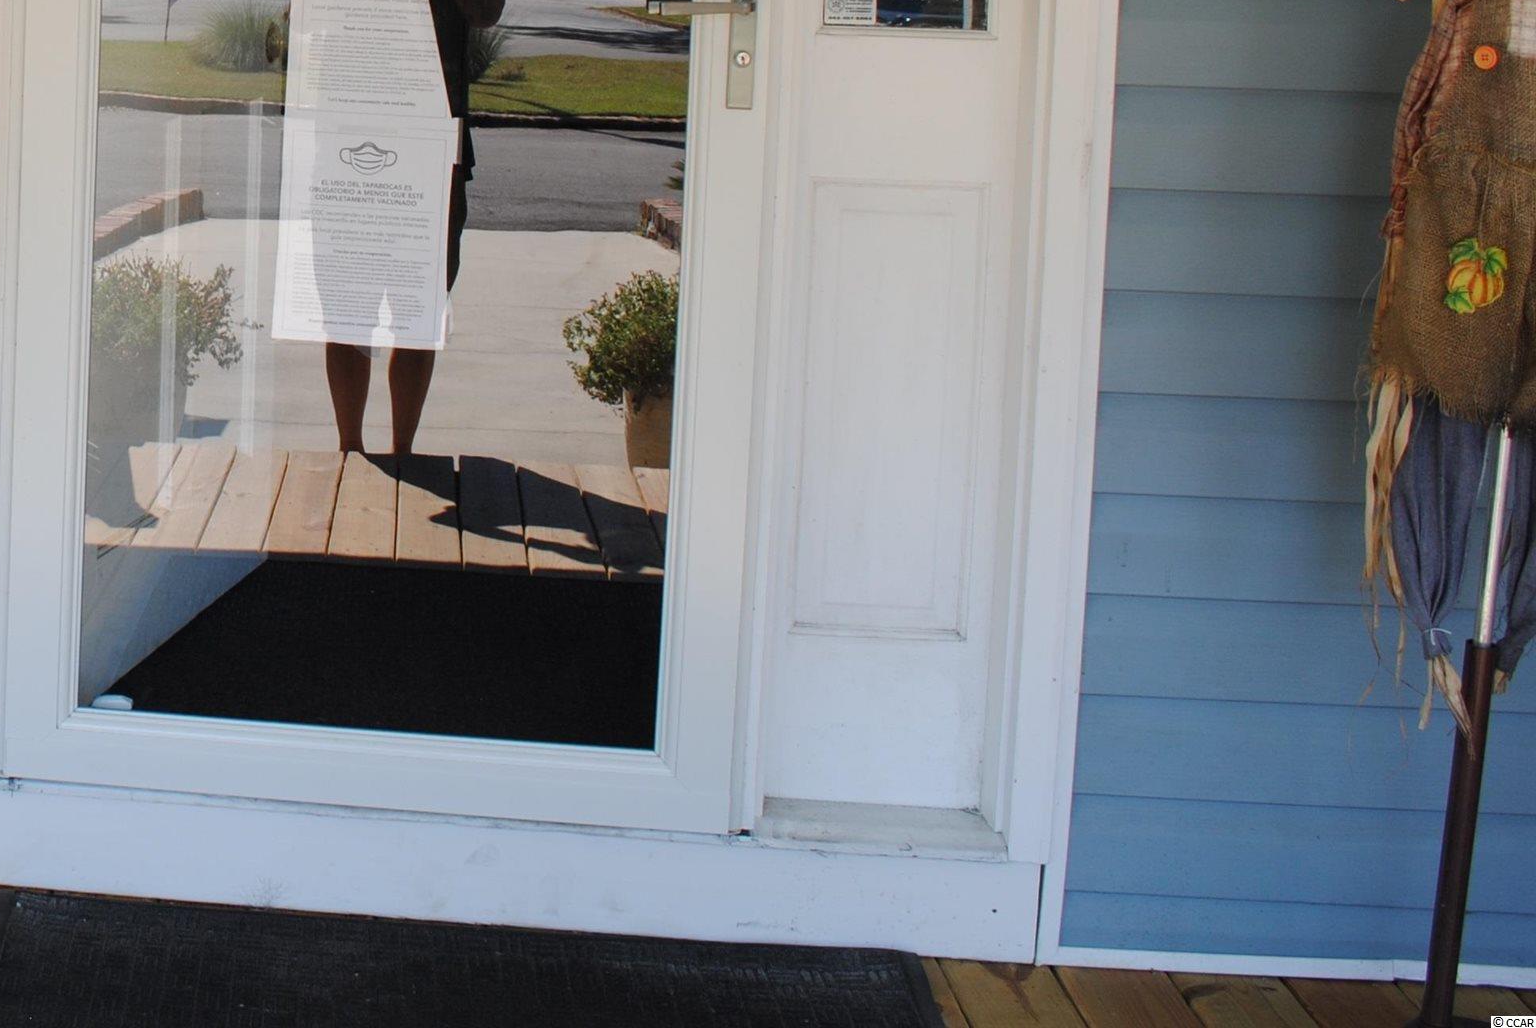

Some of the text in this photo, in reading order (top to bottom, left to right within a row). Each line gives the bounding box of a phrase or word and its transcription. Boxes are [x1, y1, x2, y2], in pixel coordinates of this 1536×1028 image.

[309, 186, 355, 195] OBLIGATORIO
[364, 190, 389, 198] MENOS
[392, 191, 405, 199] QUE
[362, 181, 403, 191] TAPABOCAS
[314, 194, 417, 207] COMPLETAMENTE VACUNADO
